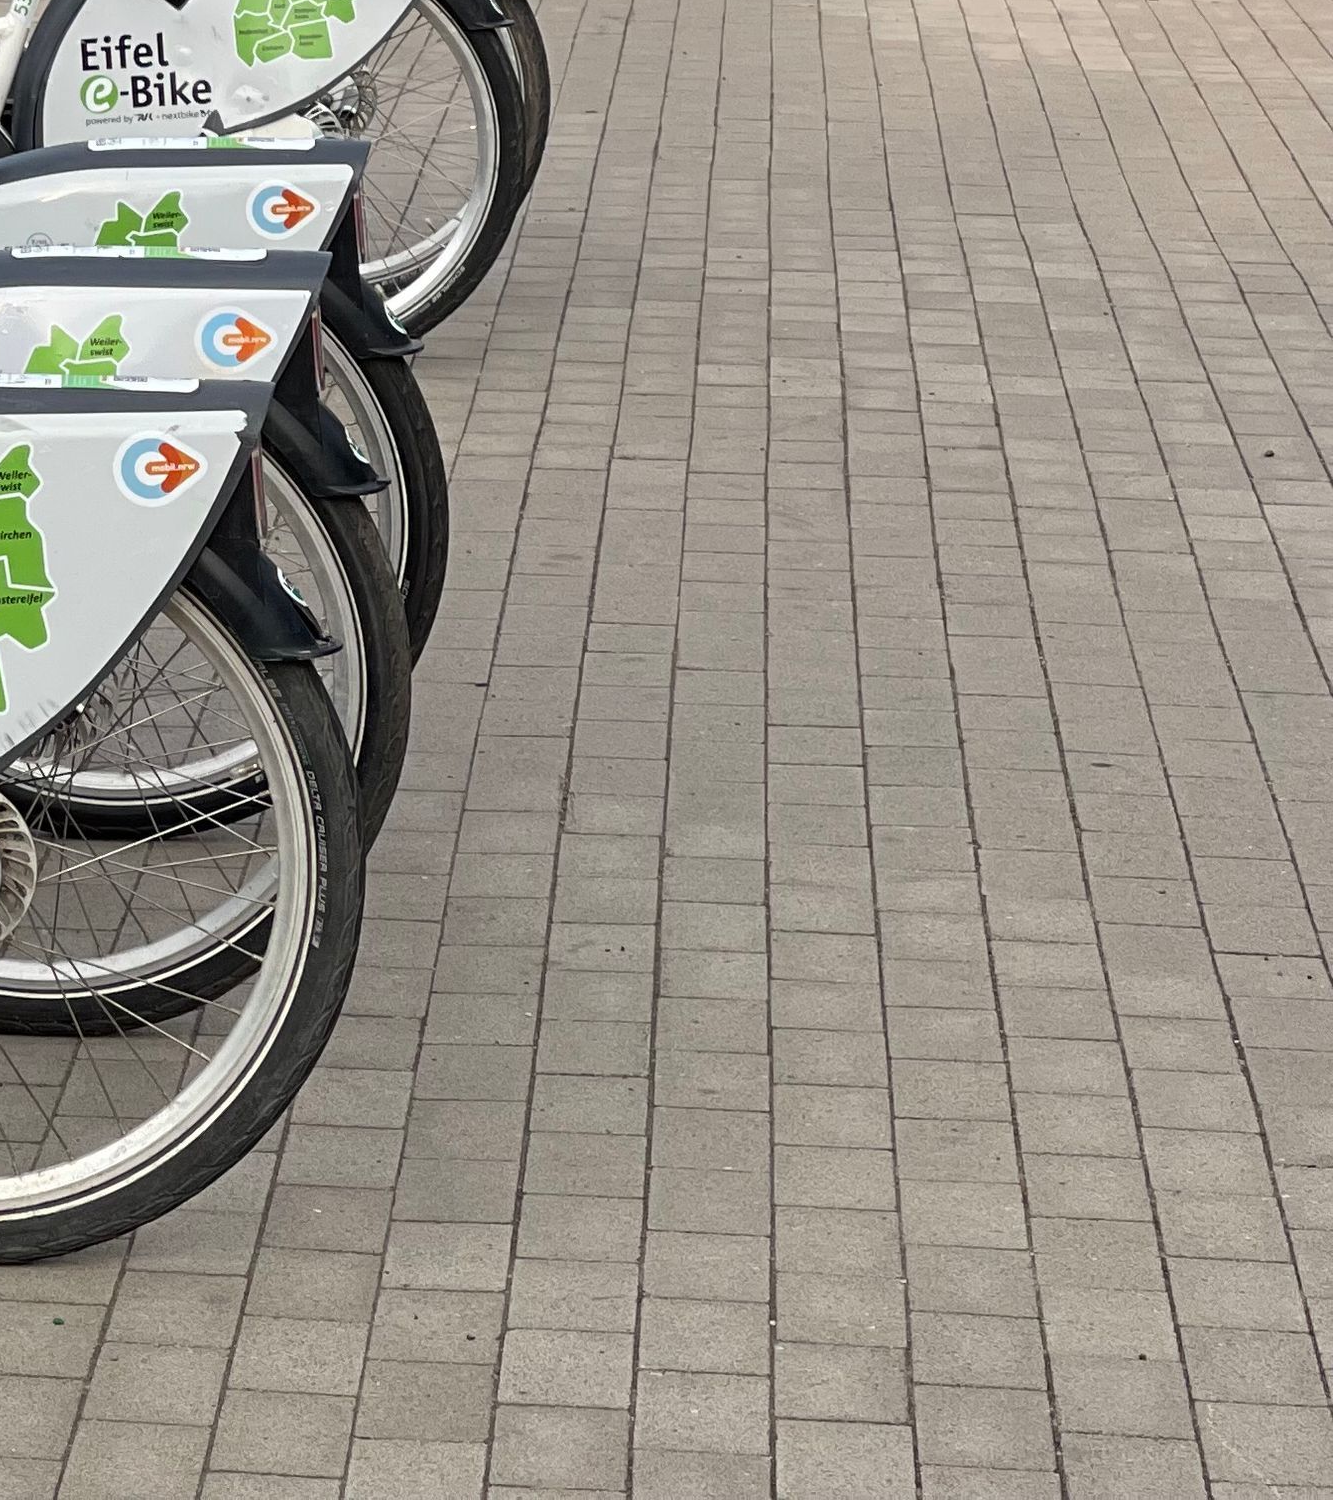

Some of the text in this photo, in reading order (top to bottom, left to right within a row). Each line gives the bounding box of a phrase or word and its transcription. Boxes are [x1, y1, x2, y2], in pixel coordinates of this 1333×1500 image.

[81, 32, 169, 71] Eifel
[80, 72, 212, 113] e-Bike
[86, 116, 121, 126] powered
[124, 116, 133, 124] by
[162, 111, 199, 120] nextbike
[90, 338, 122, 347] Weiler-
[306, 770, 327, 914] DELTA CRUISER PLUS
